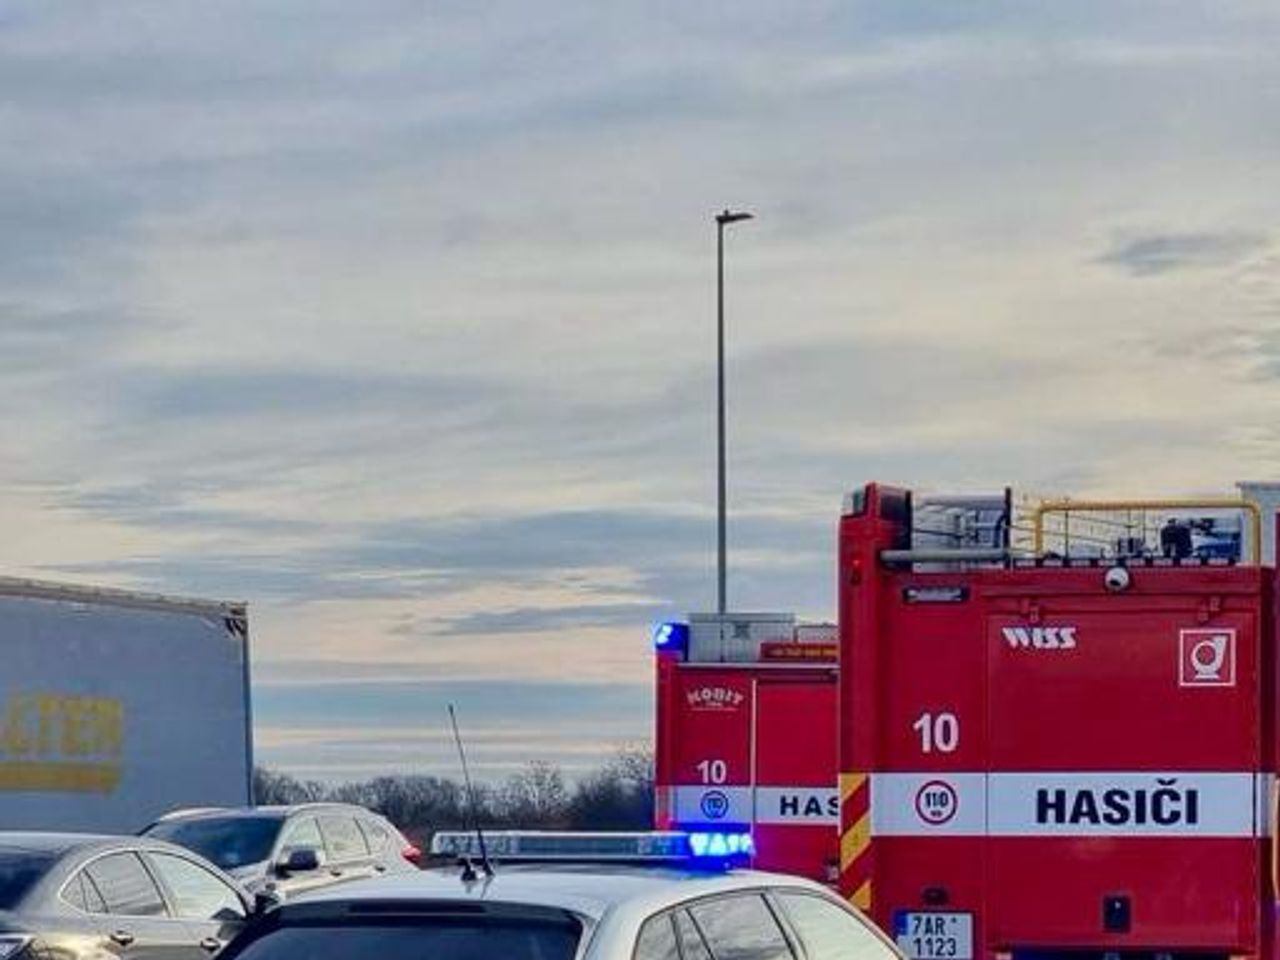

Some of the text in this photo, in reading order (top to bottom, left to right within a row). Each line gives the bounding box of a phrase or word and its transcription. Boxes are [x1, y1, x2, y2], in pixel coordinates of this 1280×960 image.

[913, 712, 959, 753] 10
[696, 760, 727, 784] 10
[1035, 778, 1198, 825] HASIČI
[913, 916, 946, 935] 7AR
[913, 937, 957, 956] 1123
